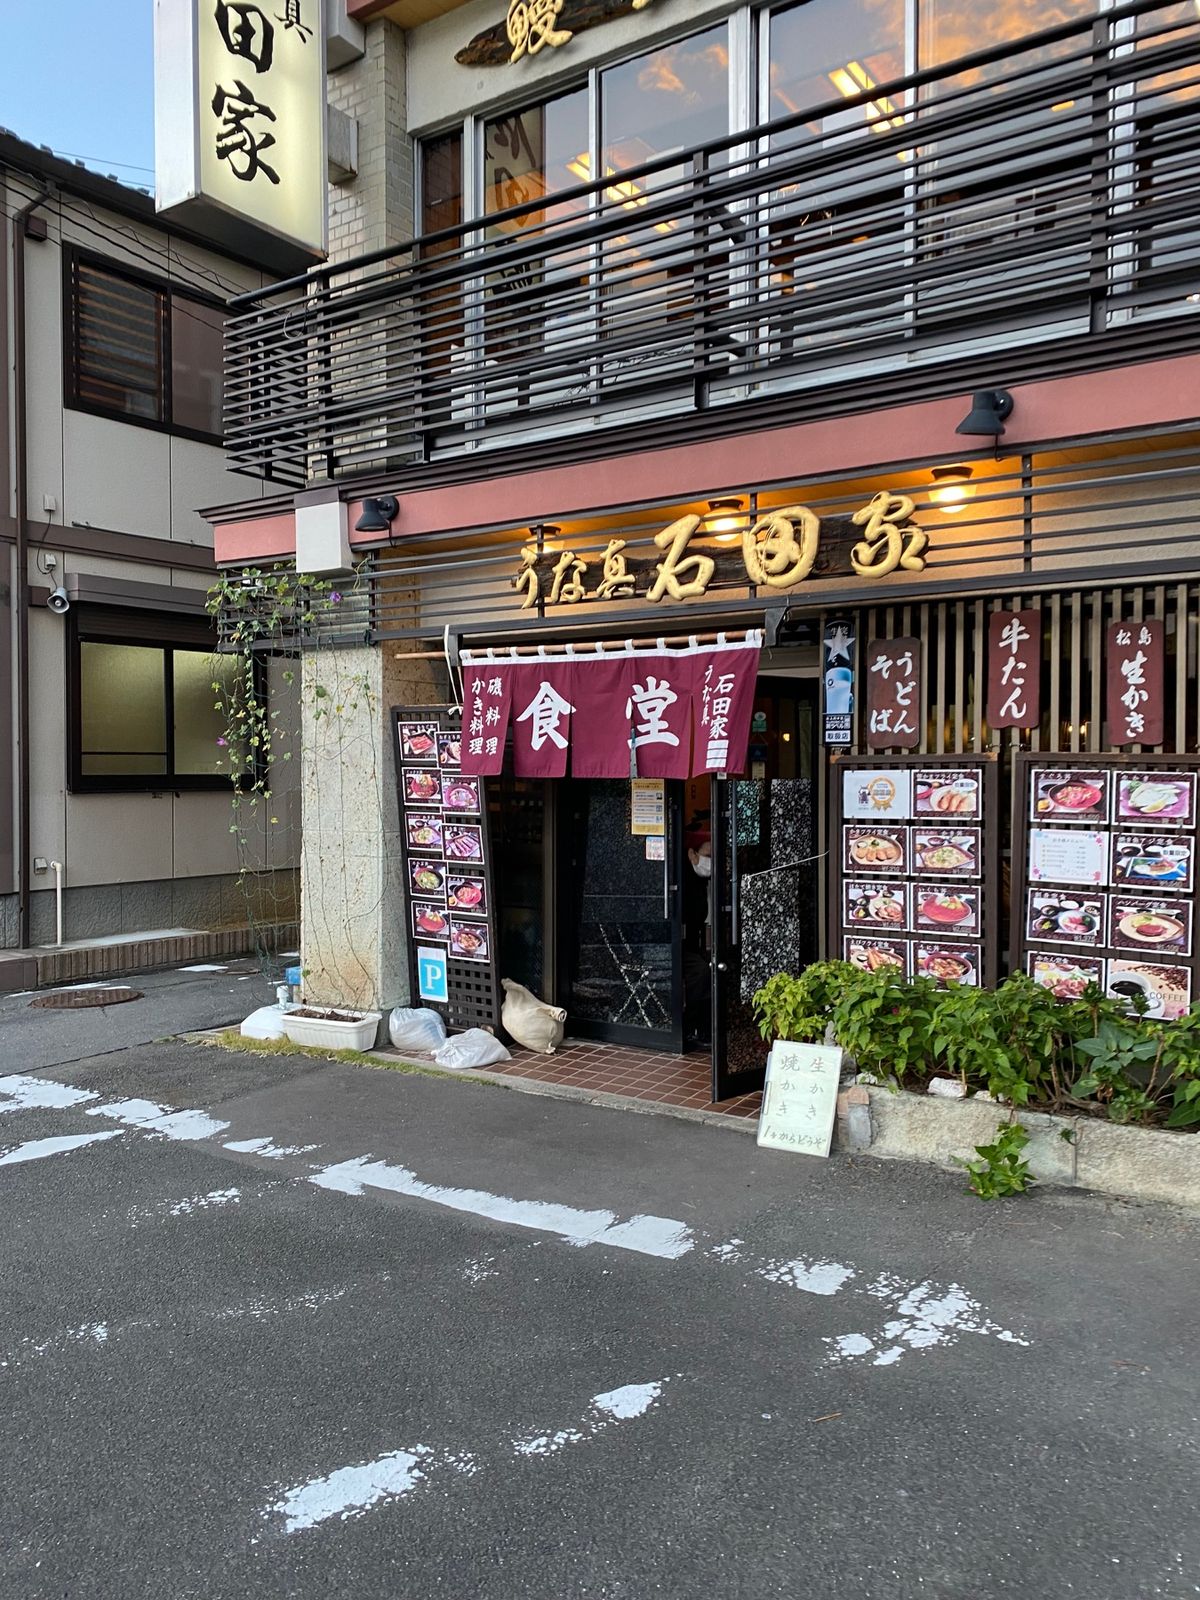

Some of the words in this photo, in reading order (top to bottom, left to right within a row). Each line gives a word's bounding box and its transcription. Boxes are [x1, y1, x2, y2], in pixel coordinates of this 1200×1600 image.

[211, 0, 281, 185] 田家
[646, 490, 930, 603] 石田家
[998, 617, 1030, 719] 牛たん
[1115, 627, 1153, 646] 松島
[468, 676, 486, 756] かき料理
[484, 677, 503, 756] 磯料理
[516, 676, 680, 752] 食堂
[708, 673, 736, 740] 石田家
[870, 653, 892, 734] そば
[893, 651, 917, 734] うどん
[1120, 650, 1149, 738] 生かき
[826, 732, 849, 740] 取扱店
[424, 963, 442, 990] P
[1149, 991, 1185, 1003] COFFEE
[775, 1053, 801, 1117] 焼かき
[805, 1056, 827, 1120] 生かき
